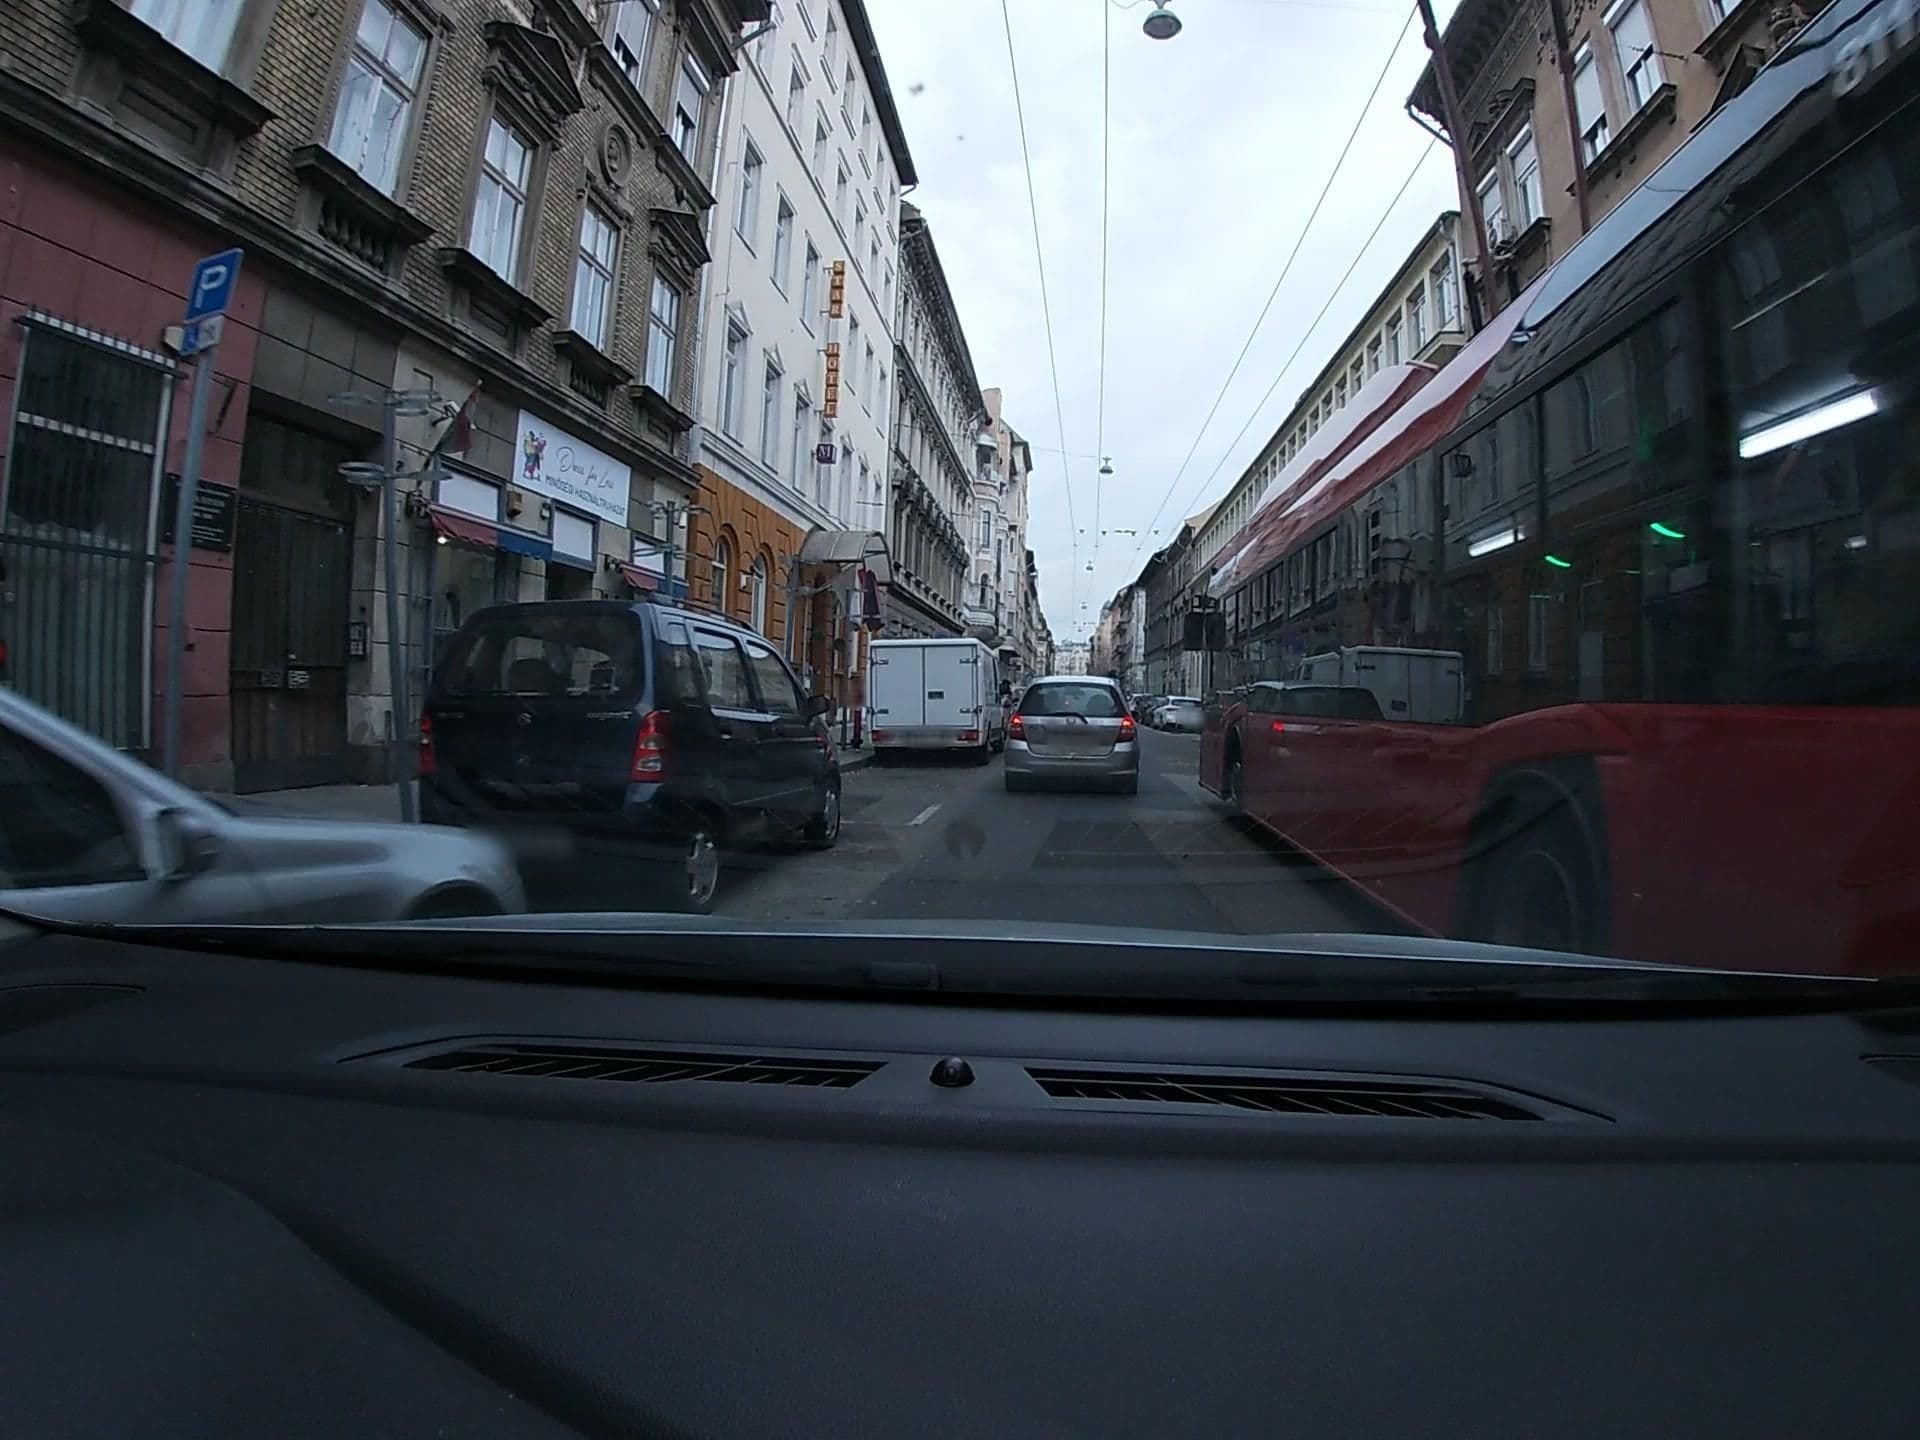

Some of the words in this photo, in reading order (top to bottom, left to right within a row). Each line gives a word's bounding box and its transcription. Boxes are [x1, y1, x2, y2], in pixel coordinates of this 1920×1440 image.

[195, 264, 228, 308] P
[830, 261, 844, 317] STAR
[826, 343, 840, 417] HOTEL
